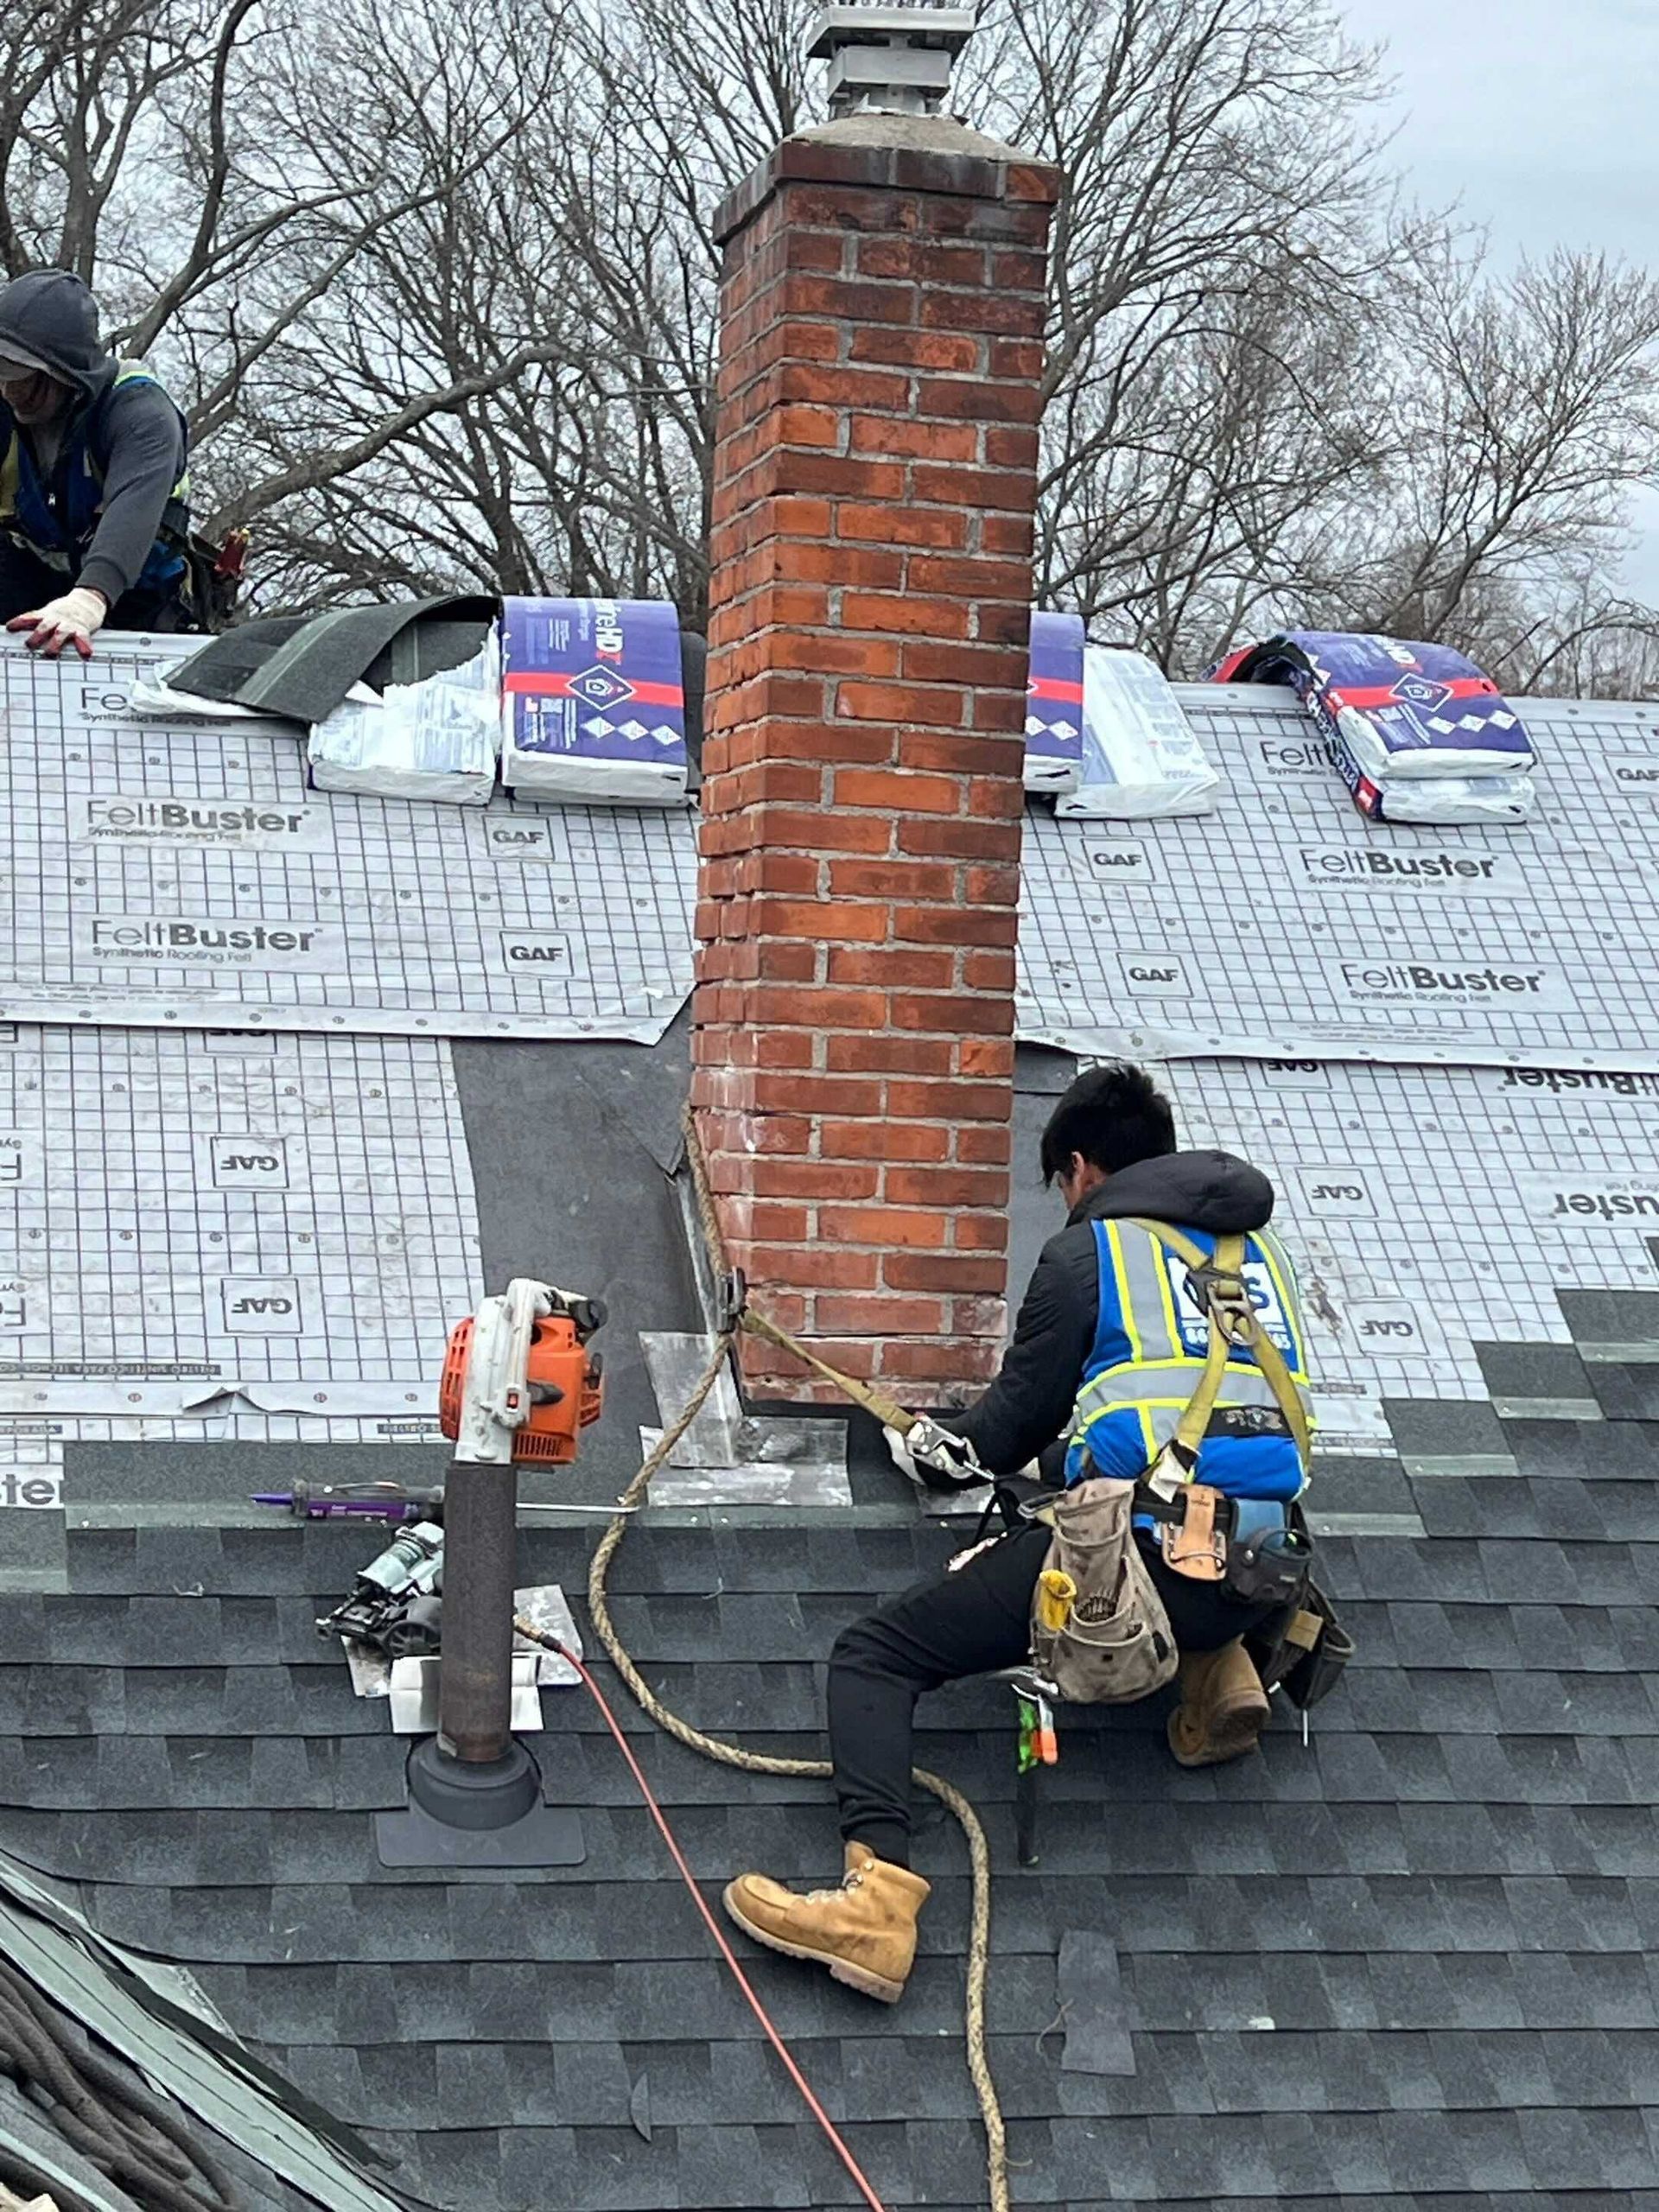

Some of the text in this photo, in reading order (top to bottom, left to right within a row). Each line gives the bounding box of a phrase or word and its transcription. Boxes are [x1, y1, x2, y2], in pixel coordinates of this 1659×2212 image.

[86, 799, 302, 832] FeltBuster
[493, 830, 544, 844] GAF
[1094, 852, 1142, 867] GAF
[1300, 849, 1494, 879] FeltBuster
[92, 919, 315, 952] FeltBuster
[510, 945, 563, 963] GAF
[1128, 966, 1179, 982] GAF
[1340, 963, 1539, 993] FeltBuster
[221, 1155, 279, 1171] GAF
[1311, 1185, 1363, 1200] GAF
[232, 1298, 293, 1314] GAF
[1358, 1320, 1413, 1337] GAF
